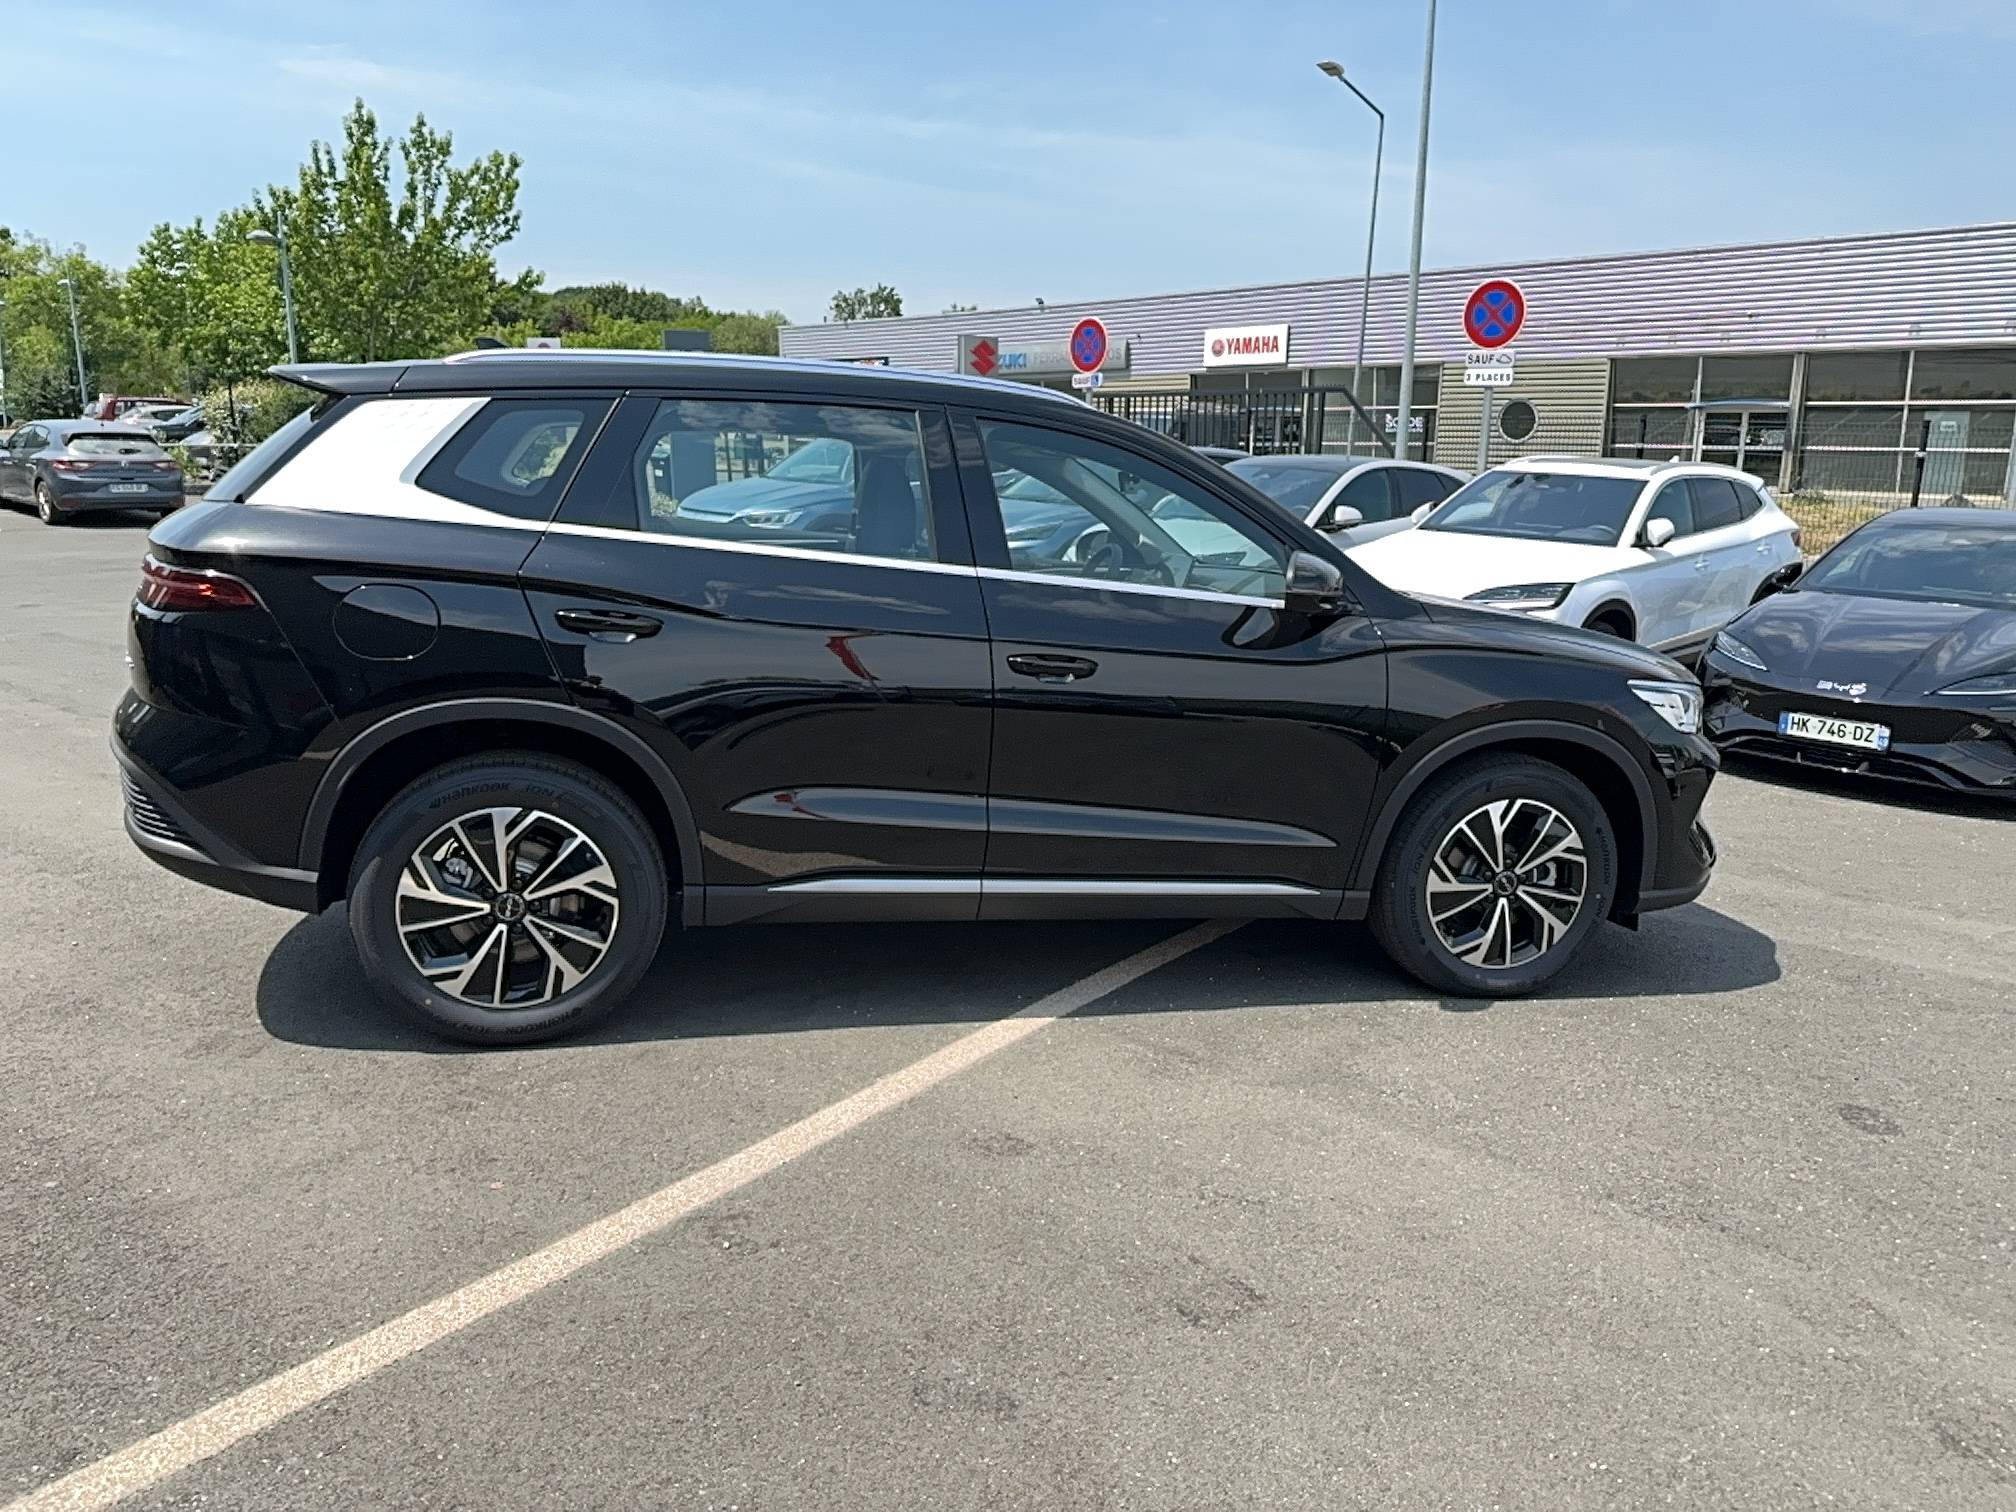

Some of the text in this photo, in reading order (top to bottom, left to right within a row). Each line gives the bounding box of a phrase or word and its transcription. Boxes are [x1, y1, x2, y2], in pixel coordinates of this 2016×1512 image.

[1226, 335, 1279, 355] YAMAHA
[998, 352, 1027, 369] ZUKI
[1467, 353, 1495, 365] SAUF
[1475, 373, 1511, 382] PLACES
